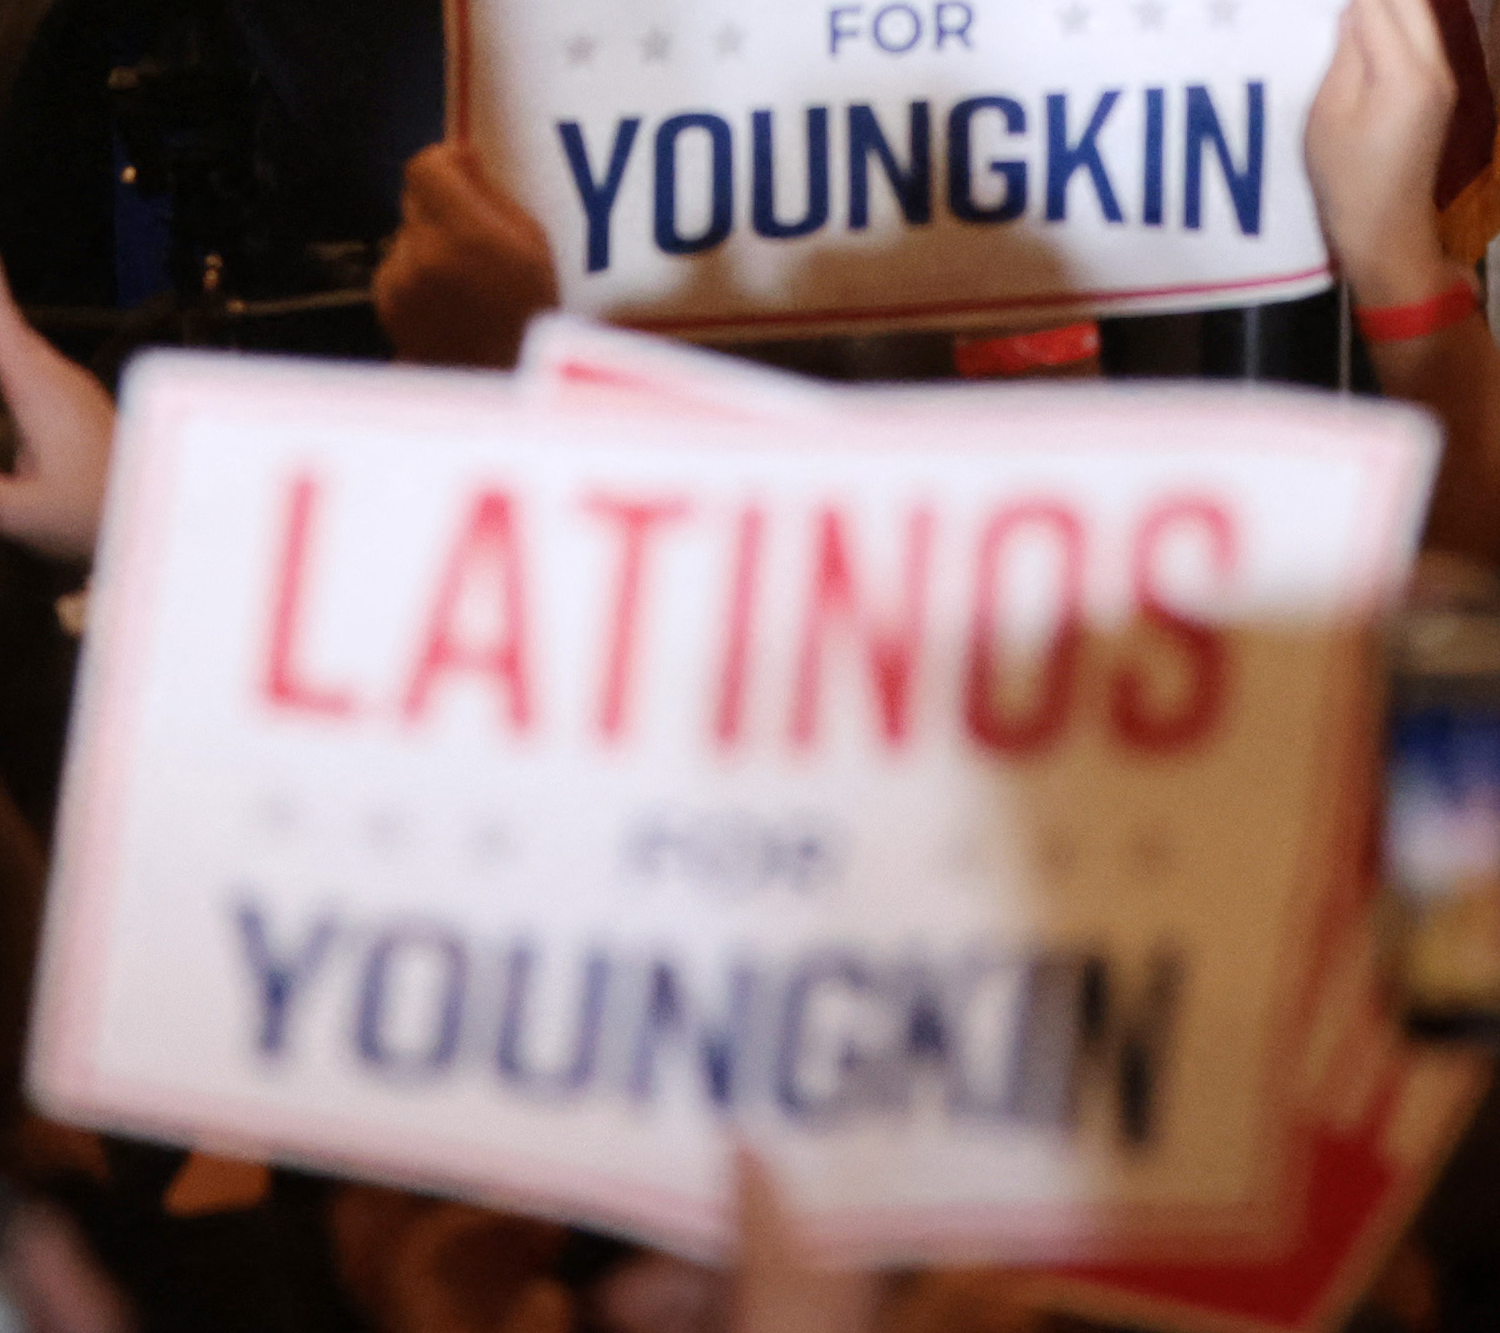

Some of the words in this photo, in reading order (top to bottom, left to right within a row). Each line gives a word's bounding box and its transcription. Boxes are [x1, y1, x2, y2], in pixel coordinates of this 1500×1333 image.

[554, 77, 1269, 276] YOUNGKIN
[256, 467, 1240, 763] LATINOS
[224, 885, 1184, 1151] YOUNGKIN
